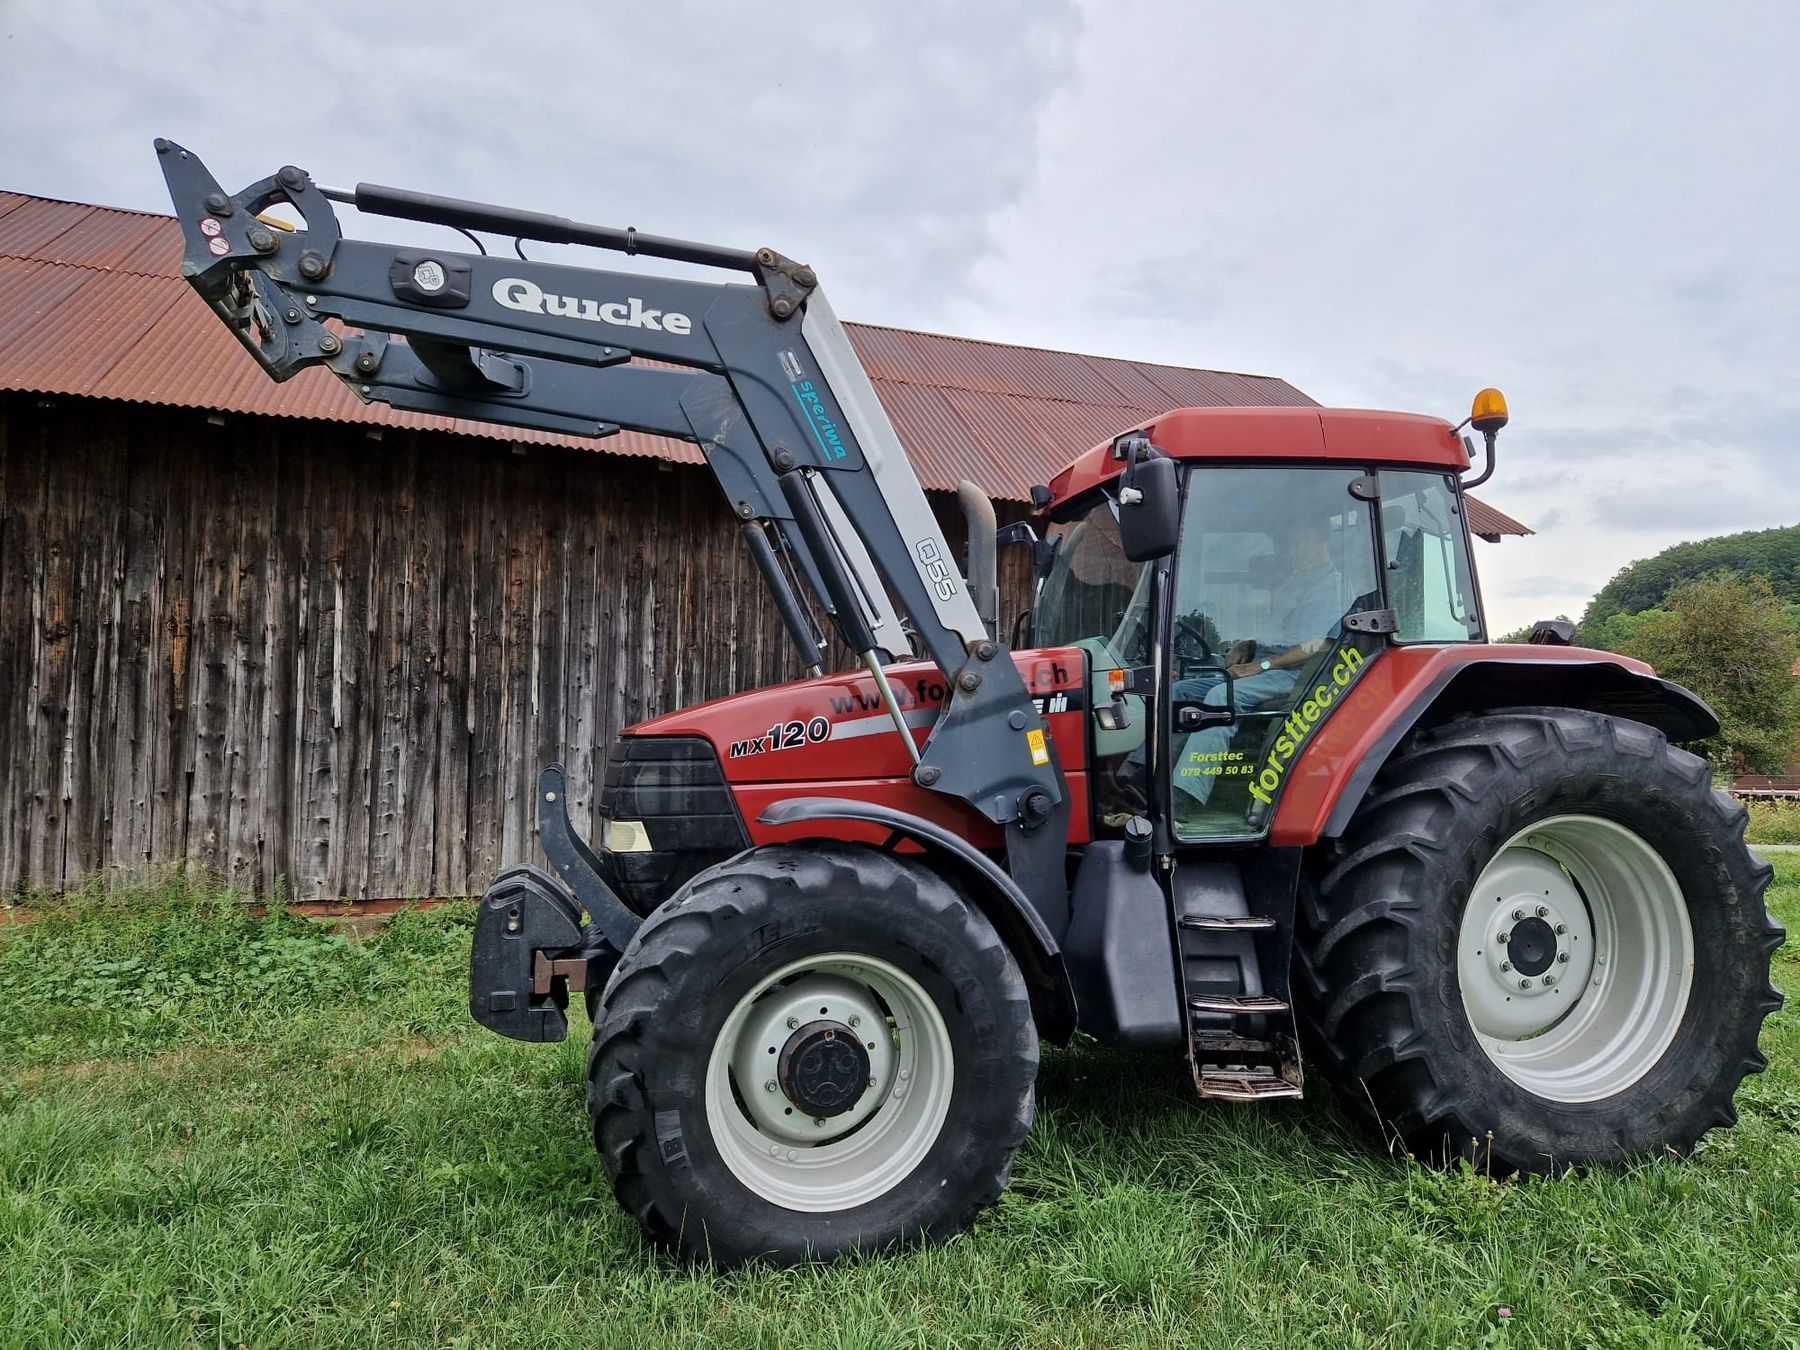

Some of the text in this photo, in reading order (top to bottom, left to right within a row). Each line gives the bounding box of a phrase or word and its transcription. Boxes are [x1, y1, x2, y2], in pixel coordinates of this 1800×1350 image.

[491, 278, 692, 335] Quicke
[1248, 646, 1365, 805] forsttec.ch
[1180, 765, 1254, 777] 079 449 50 83
[1189, 751, 1244, 762] Forsttec
